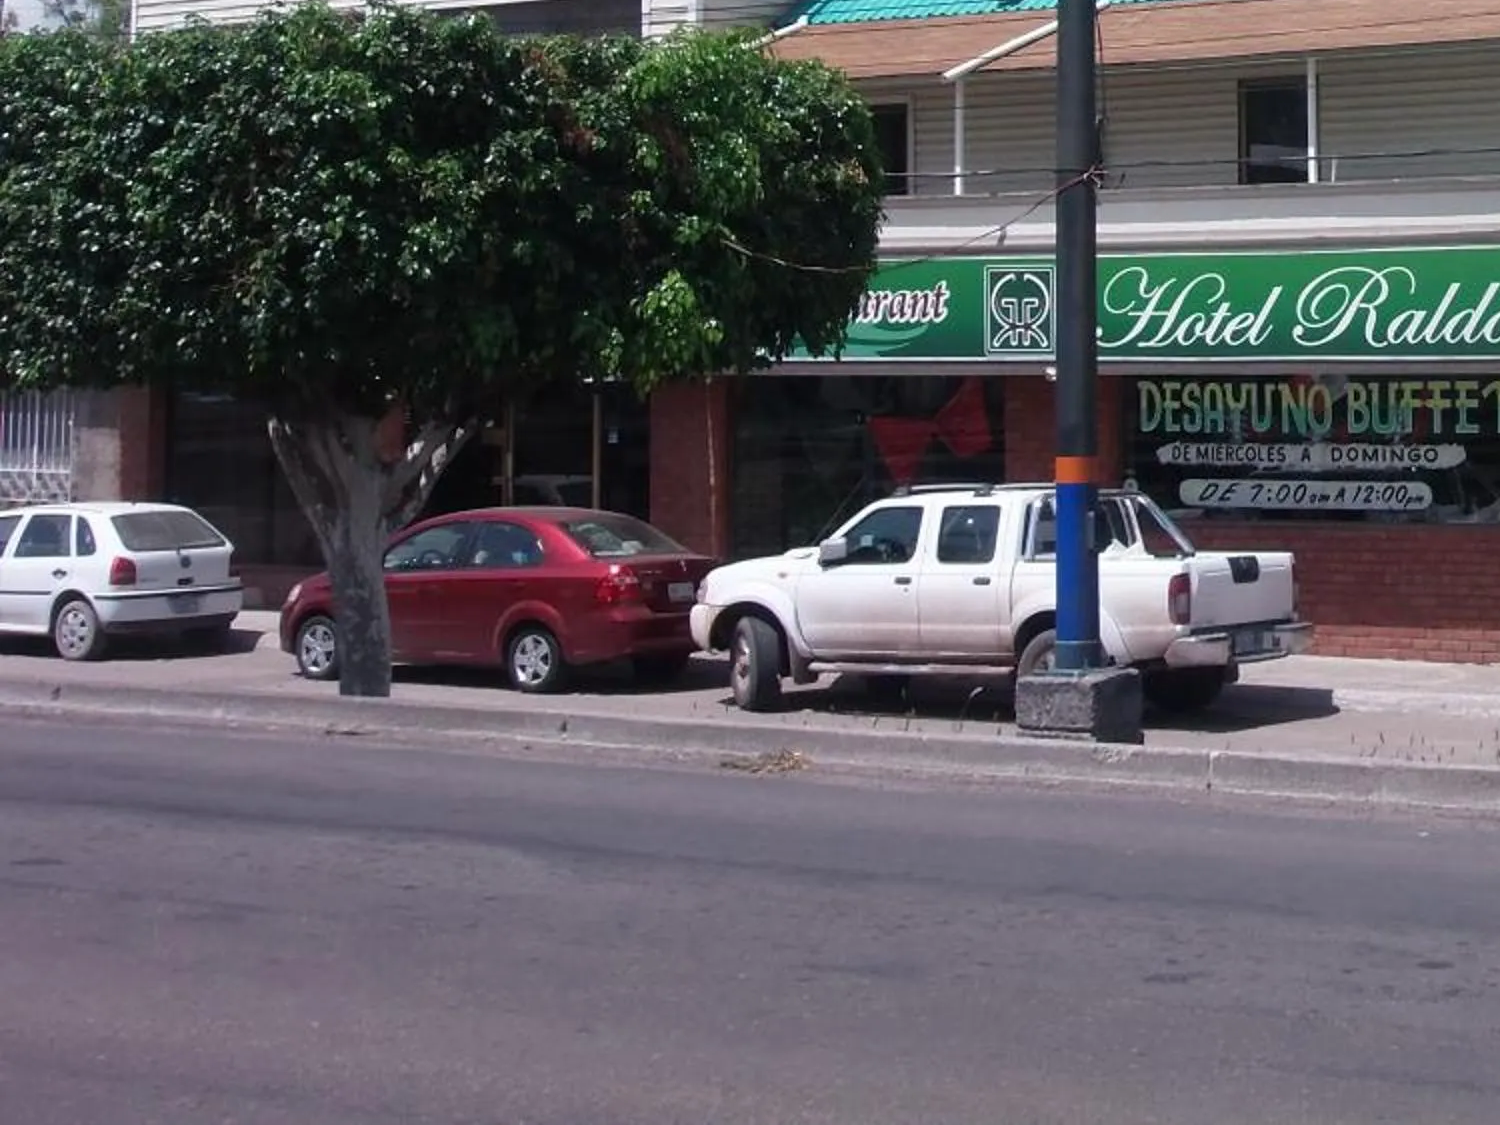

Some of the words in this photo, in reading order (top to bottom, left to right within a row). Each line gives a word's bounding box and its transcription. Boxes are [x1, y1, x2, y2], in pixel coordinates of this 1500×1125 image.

[1097, 266, 1283, 347] Hotel
[1138, 380, 1333, 434] DESAYUNO
[1172, 446, 1191, 462] DE
[1198, 445, 1286, 463] MIERCOLES
[1302, 447, 1311, 463] A
[1331, 446, 1439, 463] DOMINGO
[1200, 482, 1242, 503] DE
[1333, 487, 1346, 504] A
